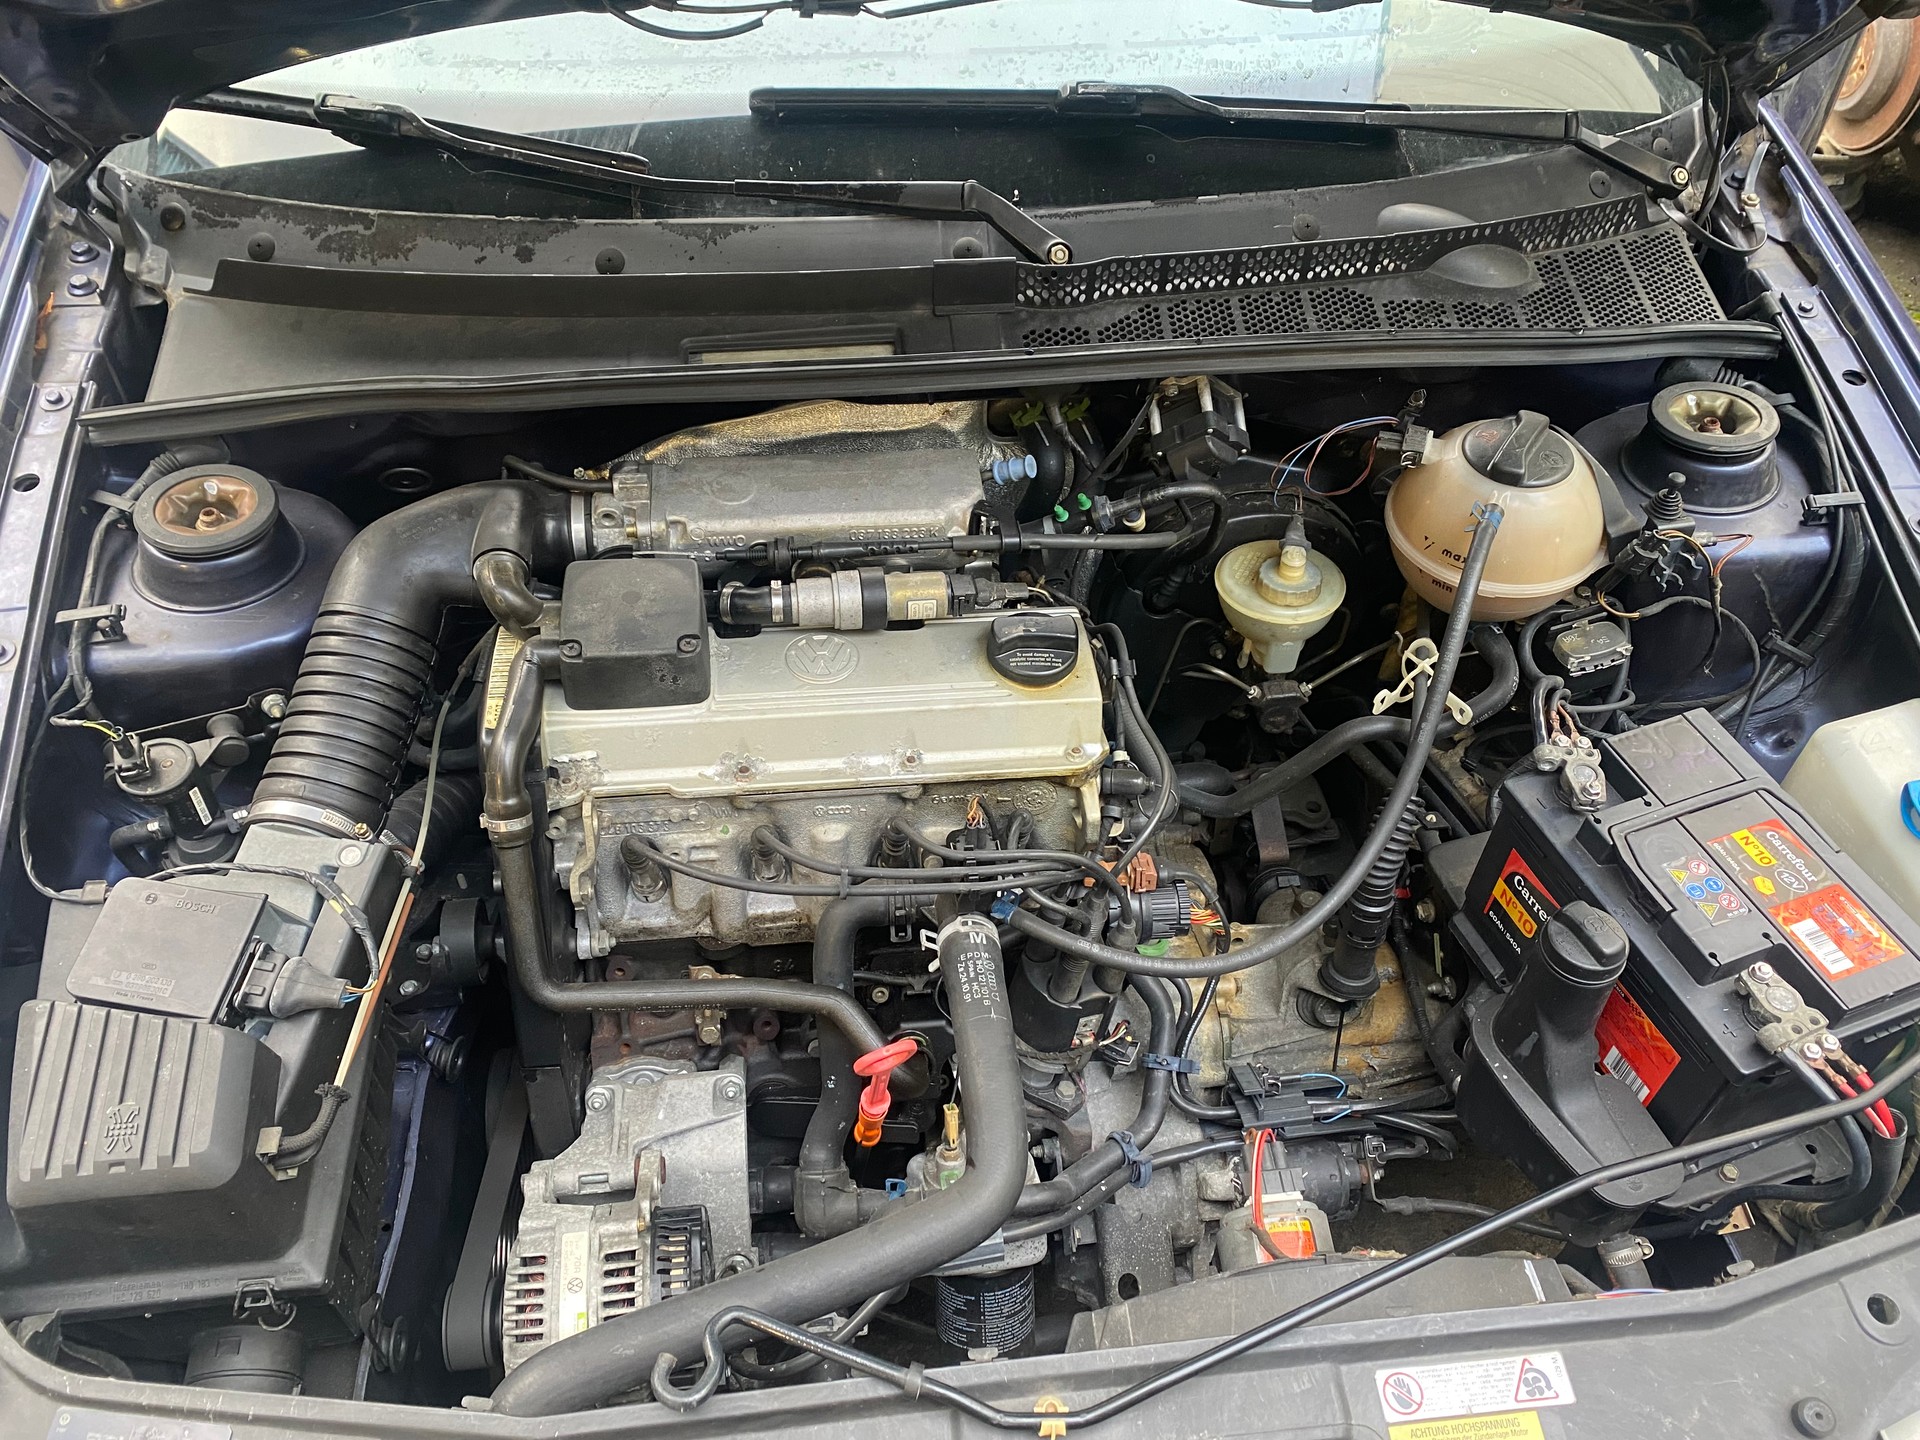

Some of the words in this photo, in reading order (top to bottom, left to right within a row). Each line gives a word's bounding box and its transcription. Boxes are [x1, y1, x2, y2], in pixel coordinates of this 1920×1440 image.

[1432, 578, 1452, 593] min
[1766, 831, 1818, 882] Carrefour
[1780, 871, 1805, 891] 12V
[175, 899, 217, 914] BOSCH
[1513, 875, 1551, 923] Carre
[969, 931, 987, 945] M
[1410, 1424, 1450, 1439] ACHTUNG
[1451, 1417, 1520, 1435] HOCHSPANNUNG
[1510, 1428, 1528, 1436] Motor
